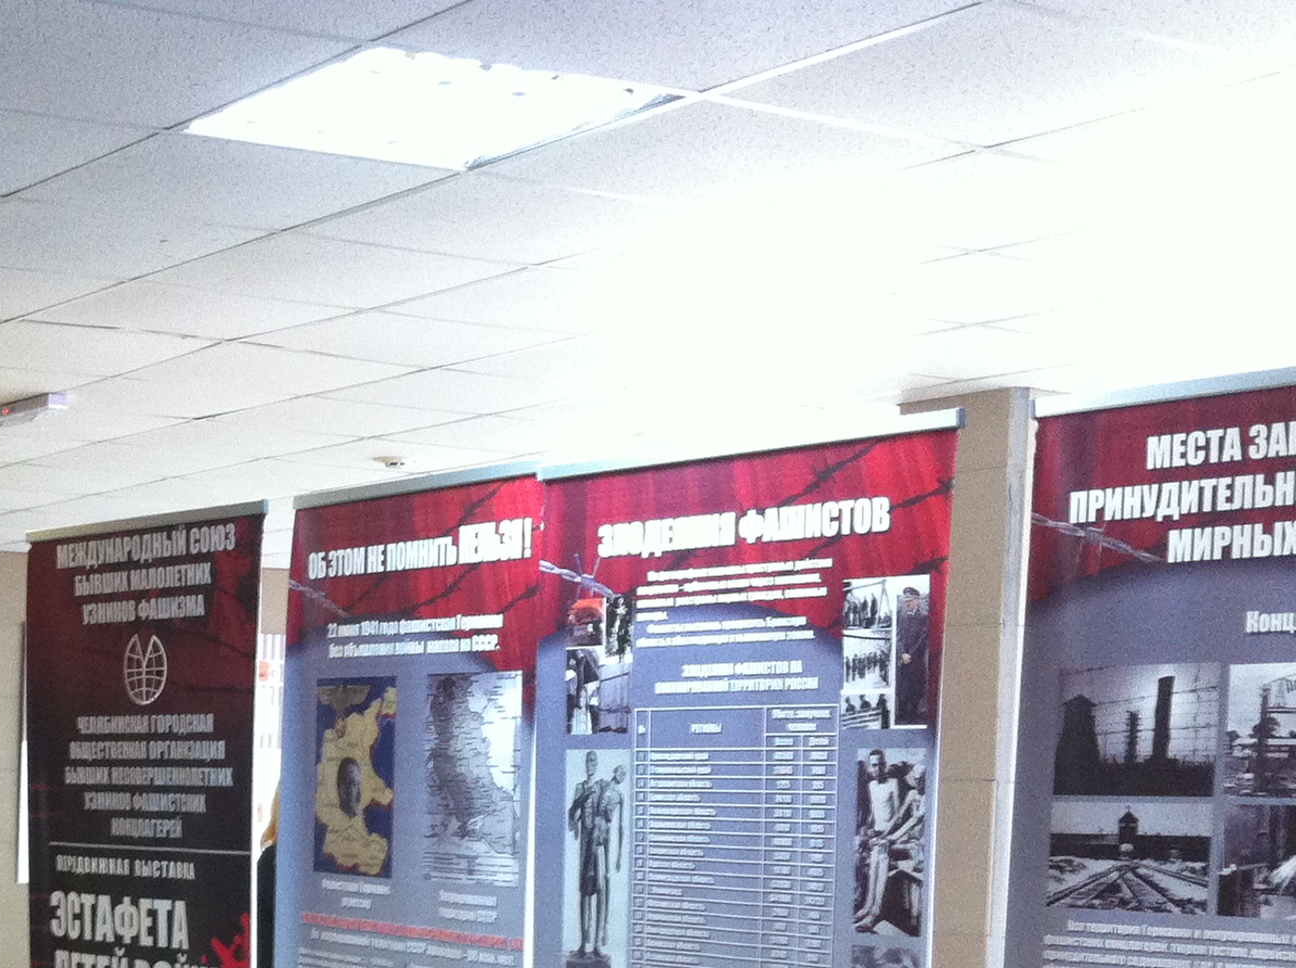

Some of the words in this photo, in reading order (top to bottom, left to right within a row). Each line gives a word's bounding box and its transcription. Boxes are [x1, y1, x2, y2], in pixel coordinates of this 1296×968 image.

[1146, 427, 1242, 470] МЕСТА
[55, 525, 187, 569] МЕЖДУНАРОДНЫЙ
[190, 522, 236, 555] СОЮЗ
[597, 511, 737, 558] ЗЛОДЕЯНИЯ
[738, 497, 891, 544] ФАШИСТОВ
[1167, 520, 1296, 563] МИРНЫХ
[74, 571, 129, 597] БЫВШИХ
[130, 562, 212, 591] МАЛОЛЕТНИХ
[308, 551, 326, 580] ОБ
[327, 547, 366, 578] ЭТОМ
[367, 545, 386, 574] НЕ
[386, 536, 458, 572] ПОМНИТЬ
[82, 599, 136, 625] УЗНИКОВ
[137, 594, 205, 621] ФАШИЗМА
[151, 713, 214, 735] ГОРОДСКАЯ
[149, 740, 226, 762] ОРГАНИЗАЦИЯ
[134, 859, 195, 880] ВЫСТАВКА
[50, 890, 189, 950] ЭСТАФЕТА
